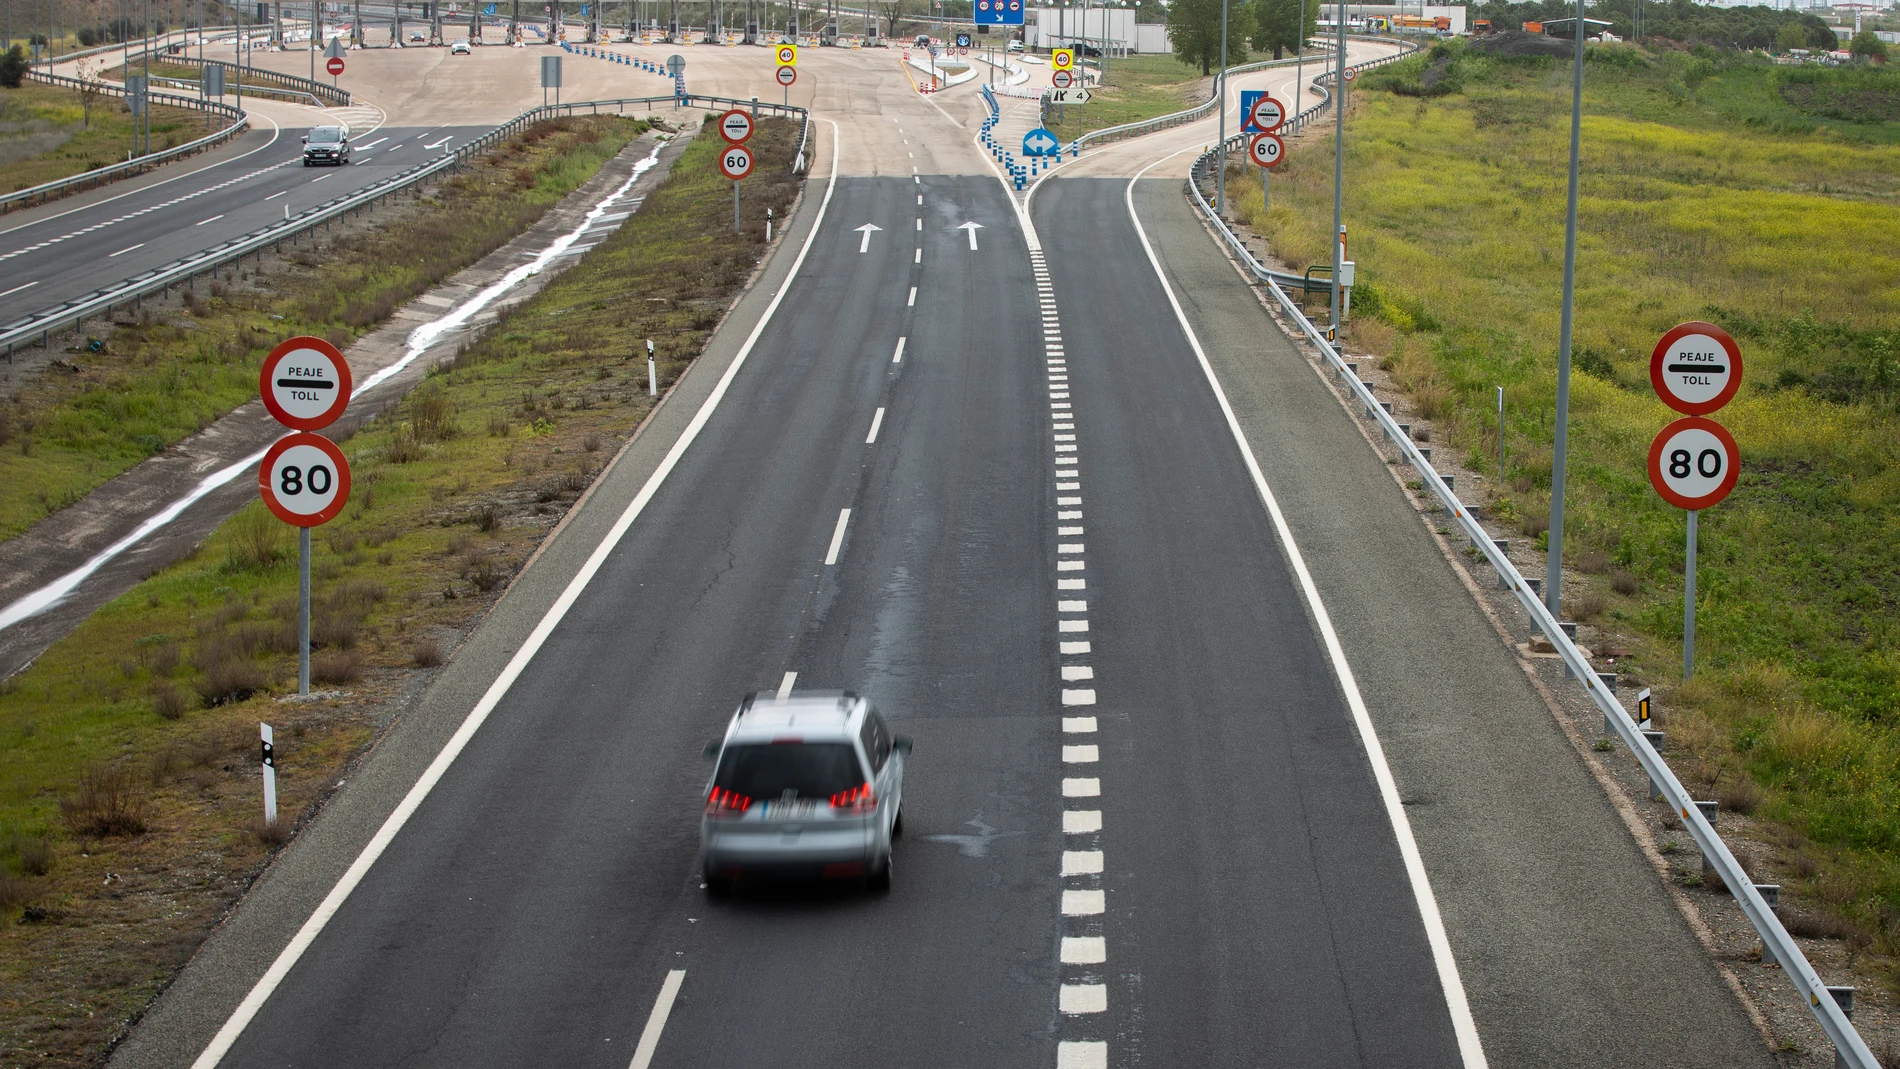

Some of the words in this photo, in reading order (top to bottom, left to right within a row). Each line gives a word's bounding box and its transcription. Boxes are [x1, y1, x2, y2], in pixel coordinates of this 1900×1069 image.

[1076, 92, 1083, 100] 4
[1257, 144, 1277, 155] 60
[727, 156, 746, 168] 60
[1679, 352, 1715, 361] PEAJE
[288, 367, 323, 377] PEAJE
[1682, 376, 1711, 385] TOLL
[291, 391, 320, 401] TOLL
[1669, 449, 1721, 479] 80
[281, 465, 331, 495] 80
